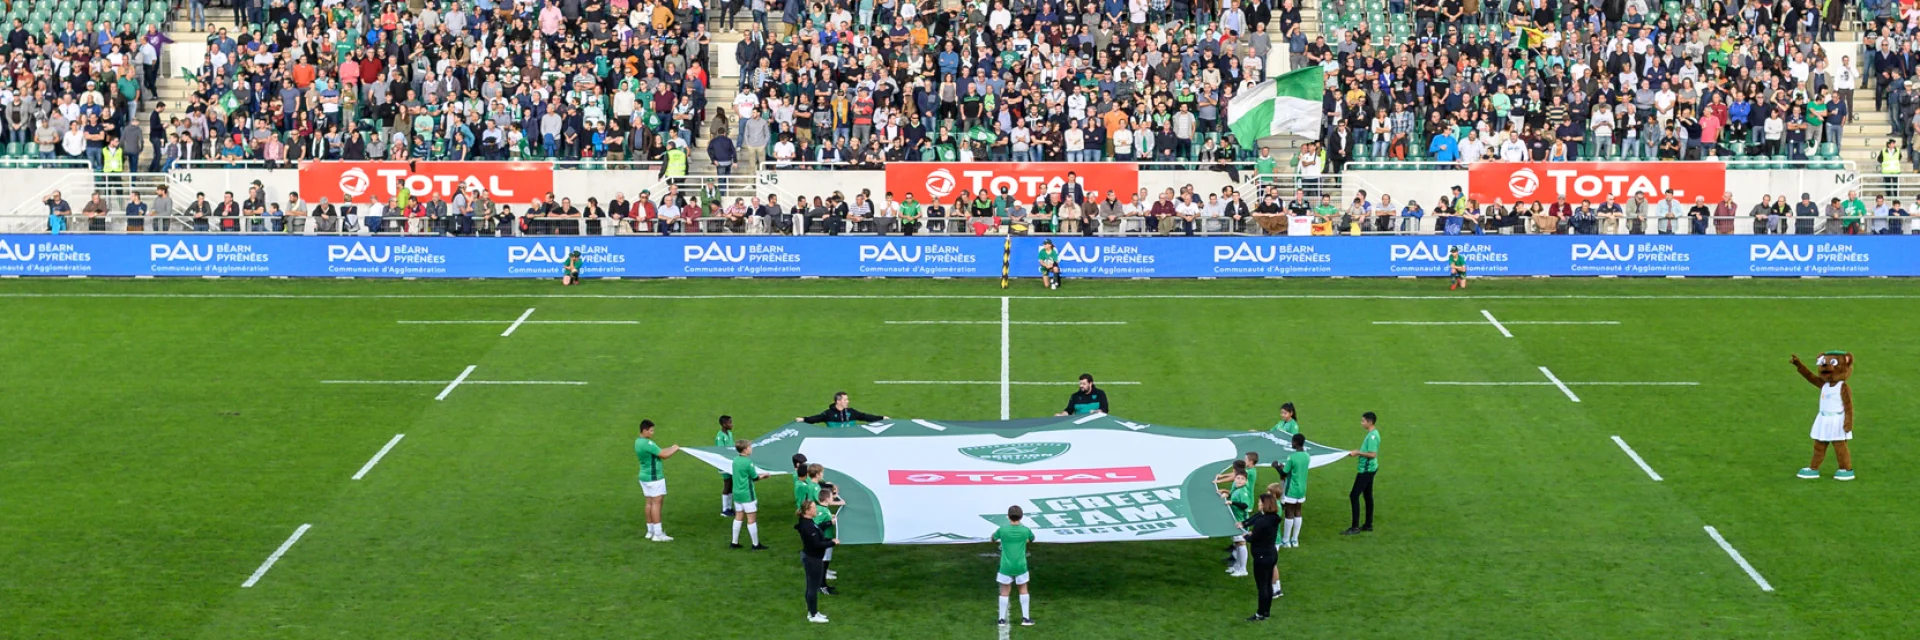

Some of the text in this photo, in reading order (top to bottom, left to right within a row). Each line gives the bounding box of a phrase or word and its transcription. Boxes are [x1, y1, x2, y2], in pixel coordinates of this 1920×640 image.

[377, 169, 513, 197] TOTAL
[963, 170, 1098, 197] TOTAL
[1547, 170, 1684, 197] TOTAL
[151, 240, 213, 262] PAU
[328, 241, 390, 263] PAU
[508, 242, 570, 263] PAU
[684, 241, 746, 262] PAU
[860, 241, 921, 262] PAU
[1214, 242, 1276, 262] PAU
[1390, 240, 1452, 262] PAU
[1572, 240, 1634, 261] PAU
[1750, 240, 1813, 262] PAU
[151, 264, 201, 272] Communauté
[1750, 264, 1801, 272] Communauté
[956, 472, 1137, 482] TOTAL
[1045, 488, 1181, 512] GREEN
[1021, 504, 1176, 528] TEAM
[1053, 521, 1177, 536] SECTION
